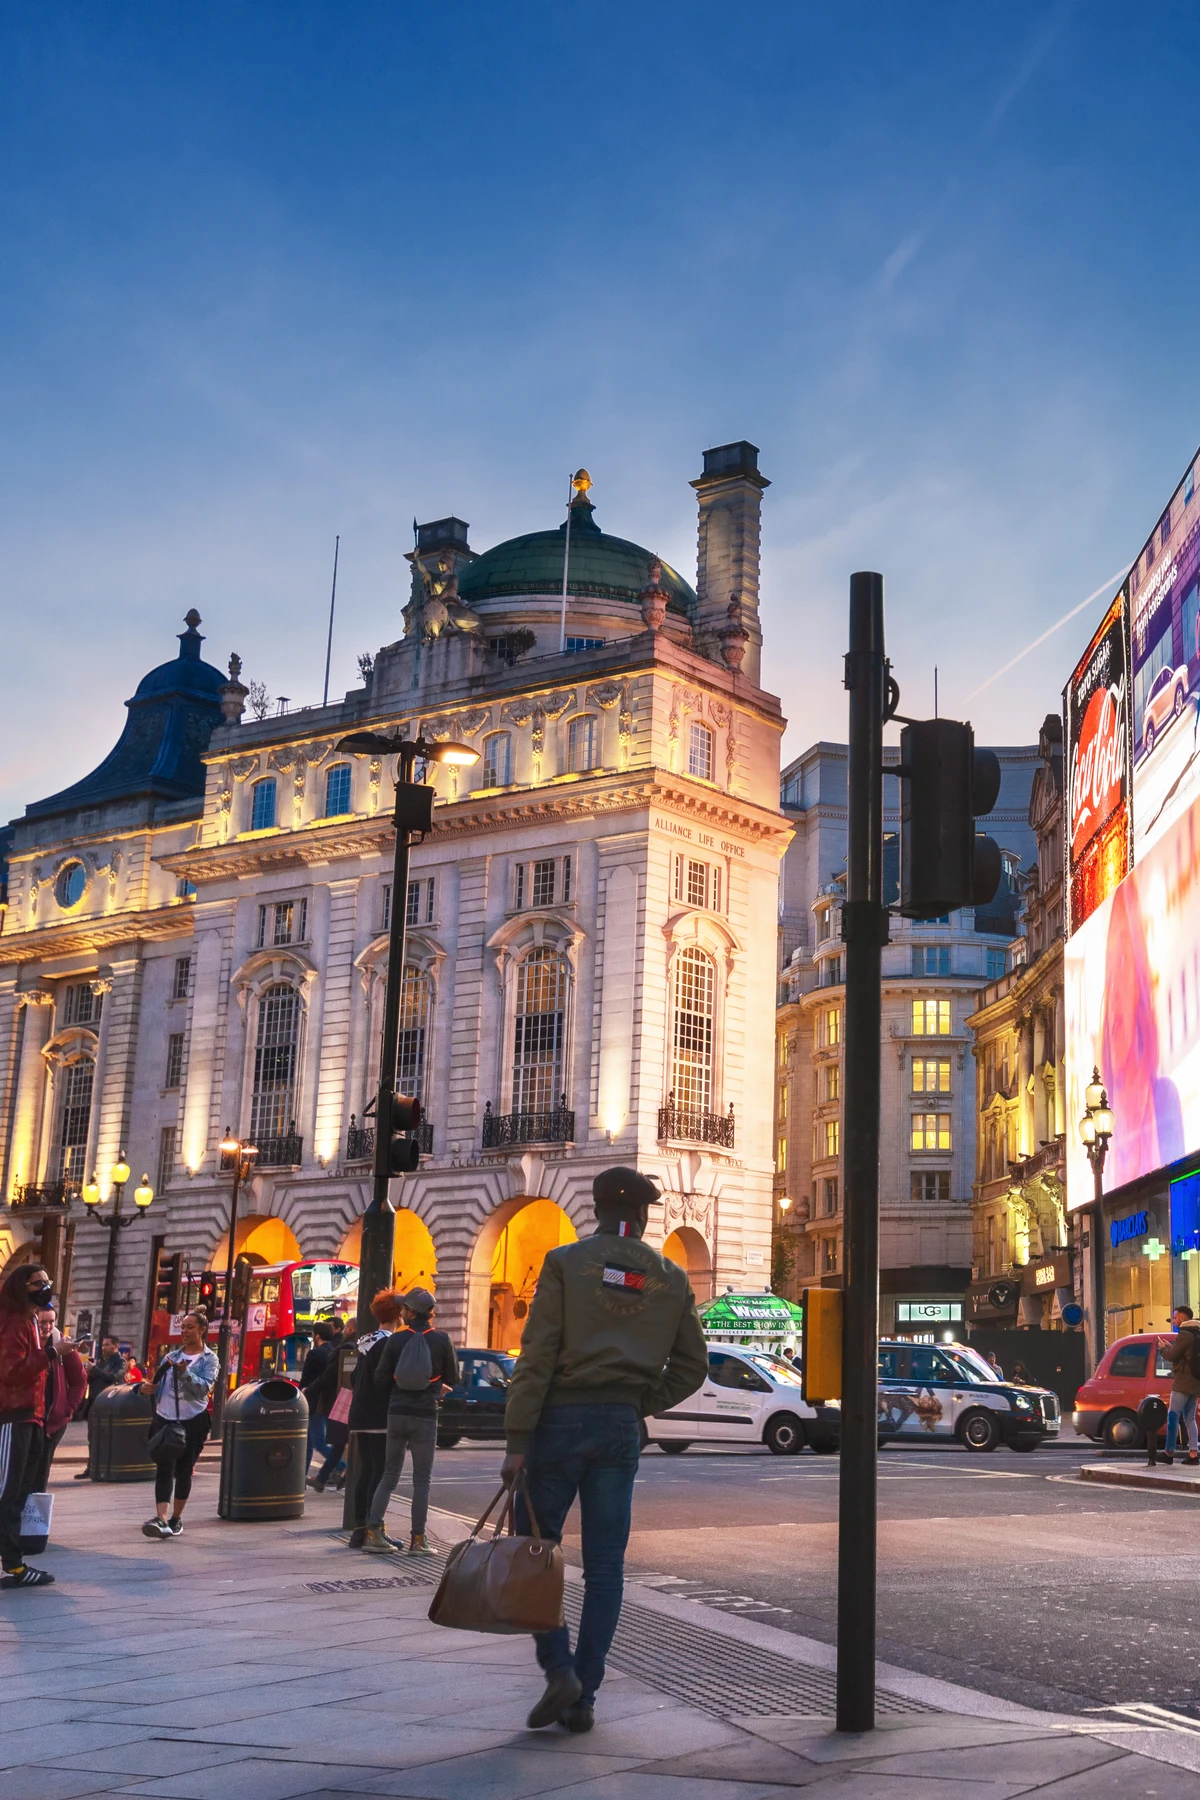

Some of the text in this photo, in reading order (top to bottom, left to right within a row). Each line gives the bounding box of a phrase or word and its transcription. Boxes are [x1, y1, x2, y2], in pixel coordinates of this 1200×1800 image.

[1136, 550, 1172, 619] Liberating you
[1136, 564, 1177, 641] from constraints
[1078, 670, 1092, 708] zero
[655, 817, 745, 858] ALLIANCE LIFE OFFICE
[450, 1156, 510, 1168] ALLIANCE
[541, 1151, 569, 1161] LIFE
[1117, 1210, 1148, 1243] BARCLAYS
[918, 1305, 942, 1317] UGG
